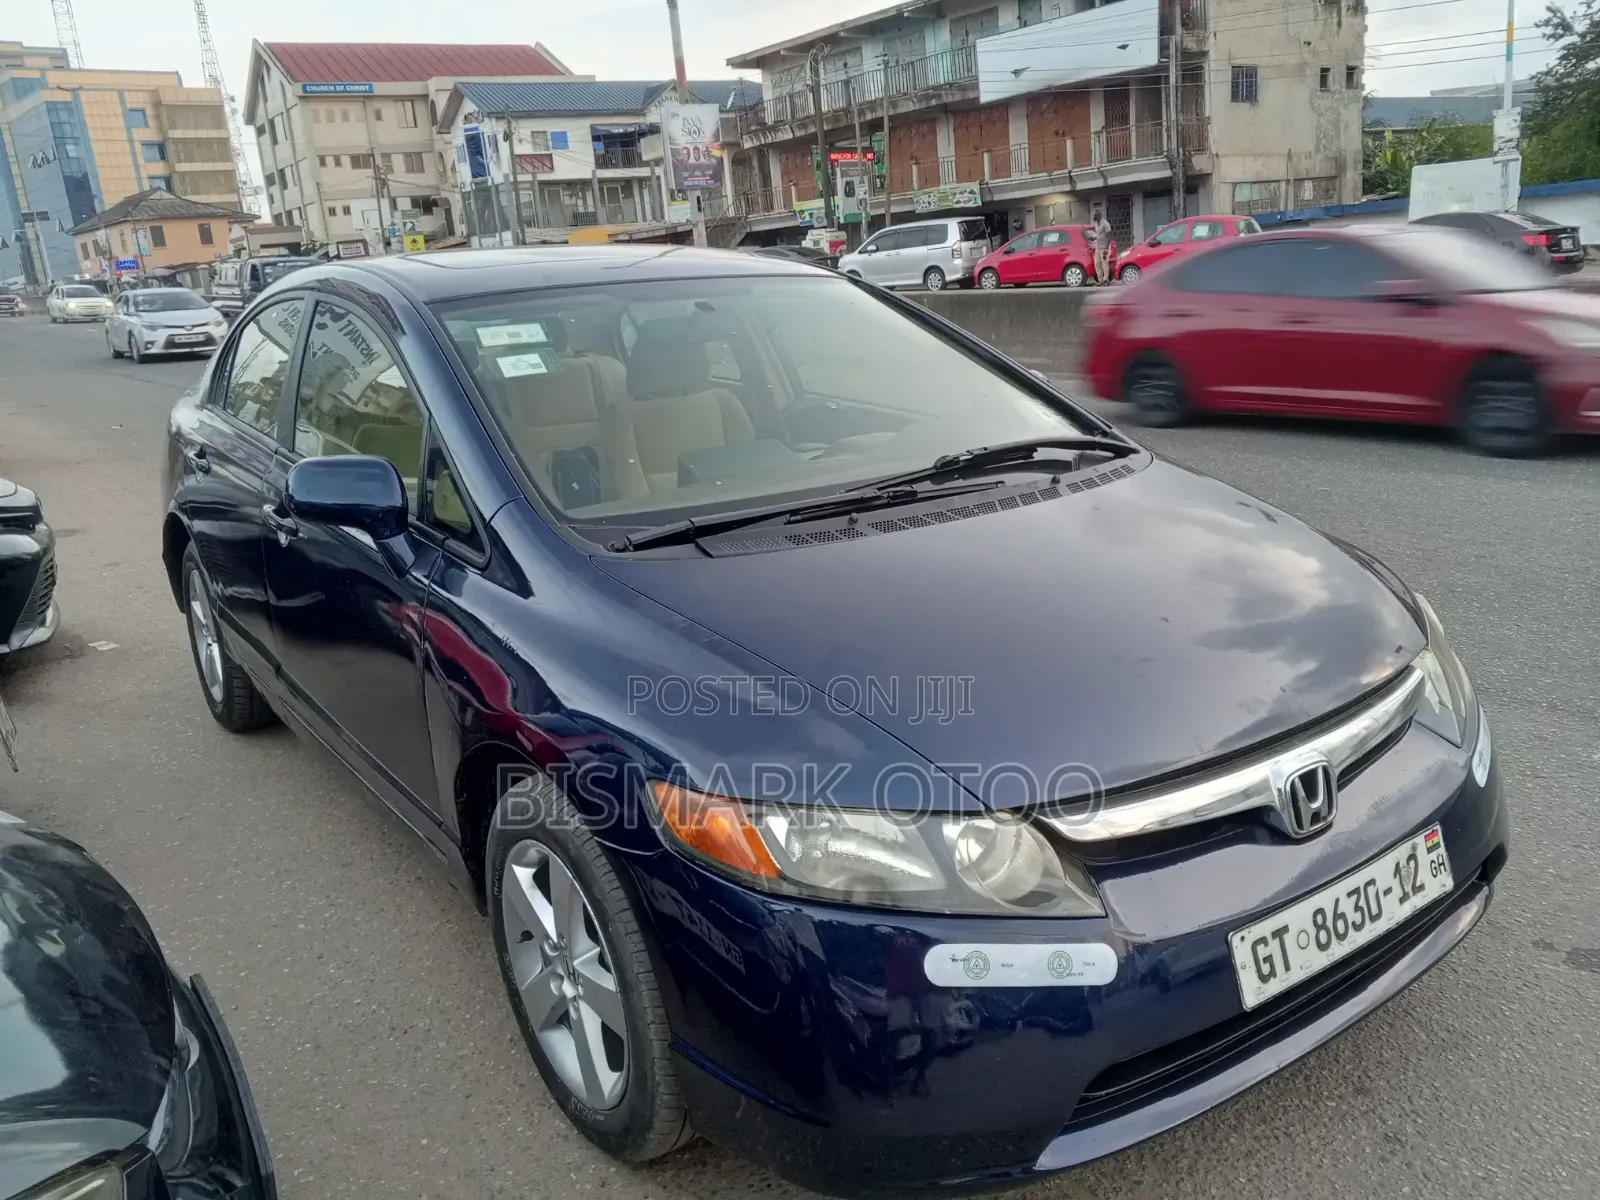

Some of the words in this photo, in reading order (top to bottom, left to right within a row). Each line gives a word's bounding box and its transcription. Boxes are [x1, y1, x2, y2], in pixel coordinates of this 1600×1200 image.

[345, 84, 370, 92] CHRIST
[1429, 853, 1447, 879] GH
[1251, 924, 1291, 984] GT
[1312, 852, 1425, 952] 8630-12
